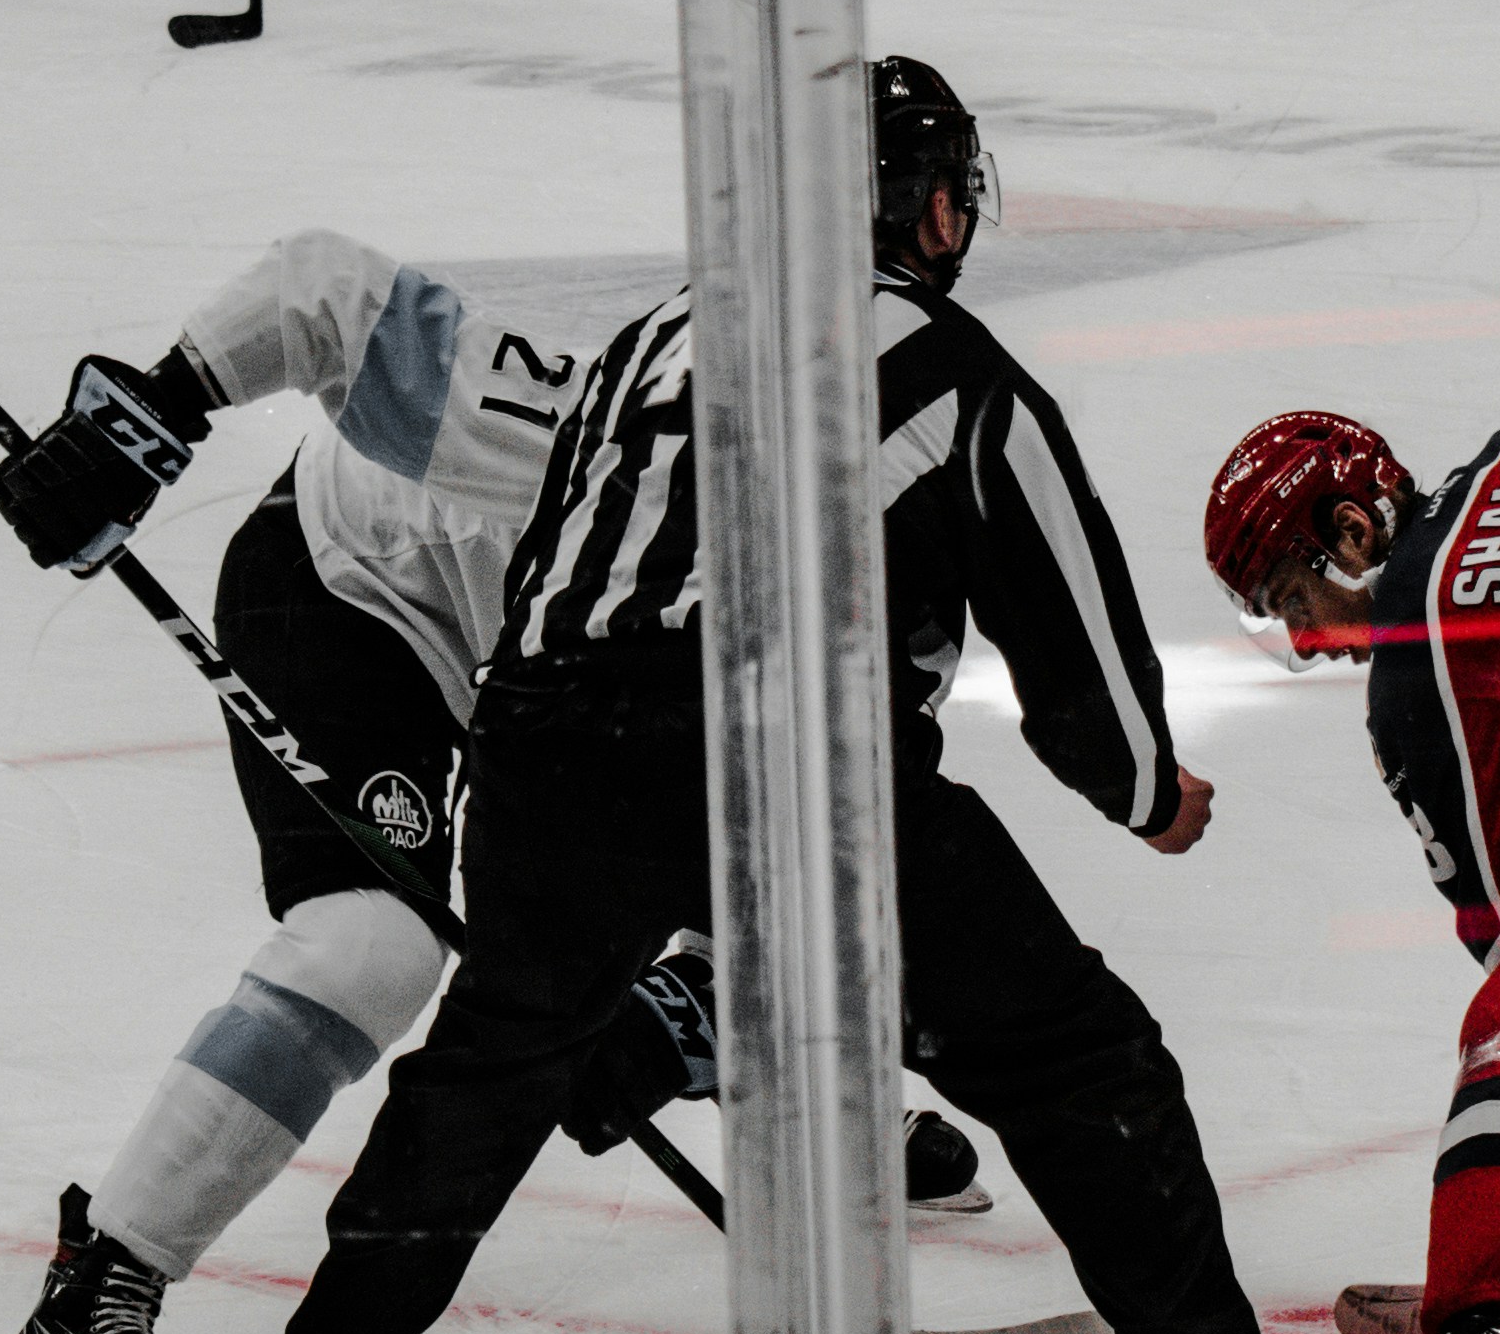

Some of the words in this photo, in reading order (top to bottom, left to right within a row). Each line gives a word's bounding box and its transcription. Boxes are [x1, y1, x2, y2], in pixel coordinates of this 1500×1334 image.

[480, 331, 577, 430] 12
[1278, 456, 1317, 499] CCM
[159, 612, 330, 784] CCM
